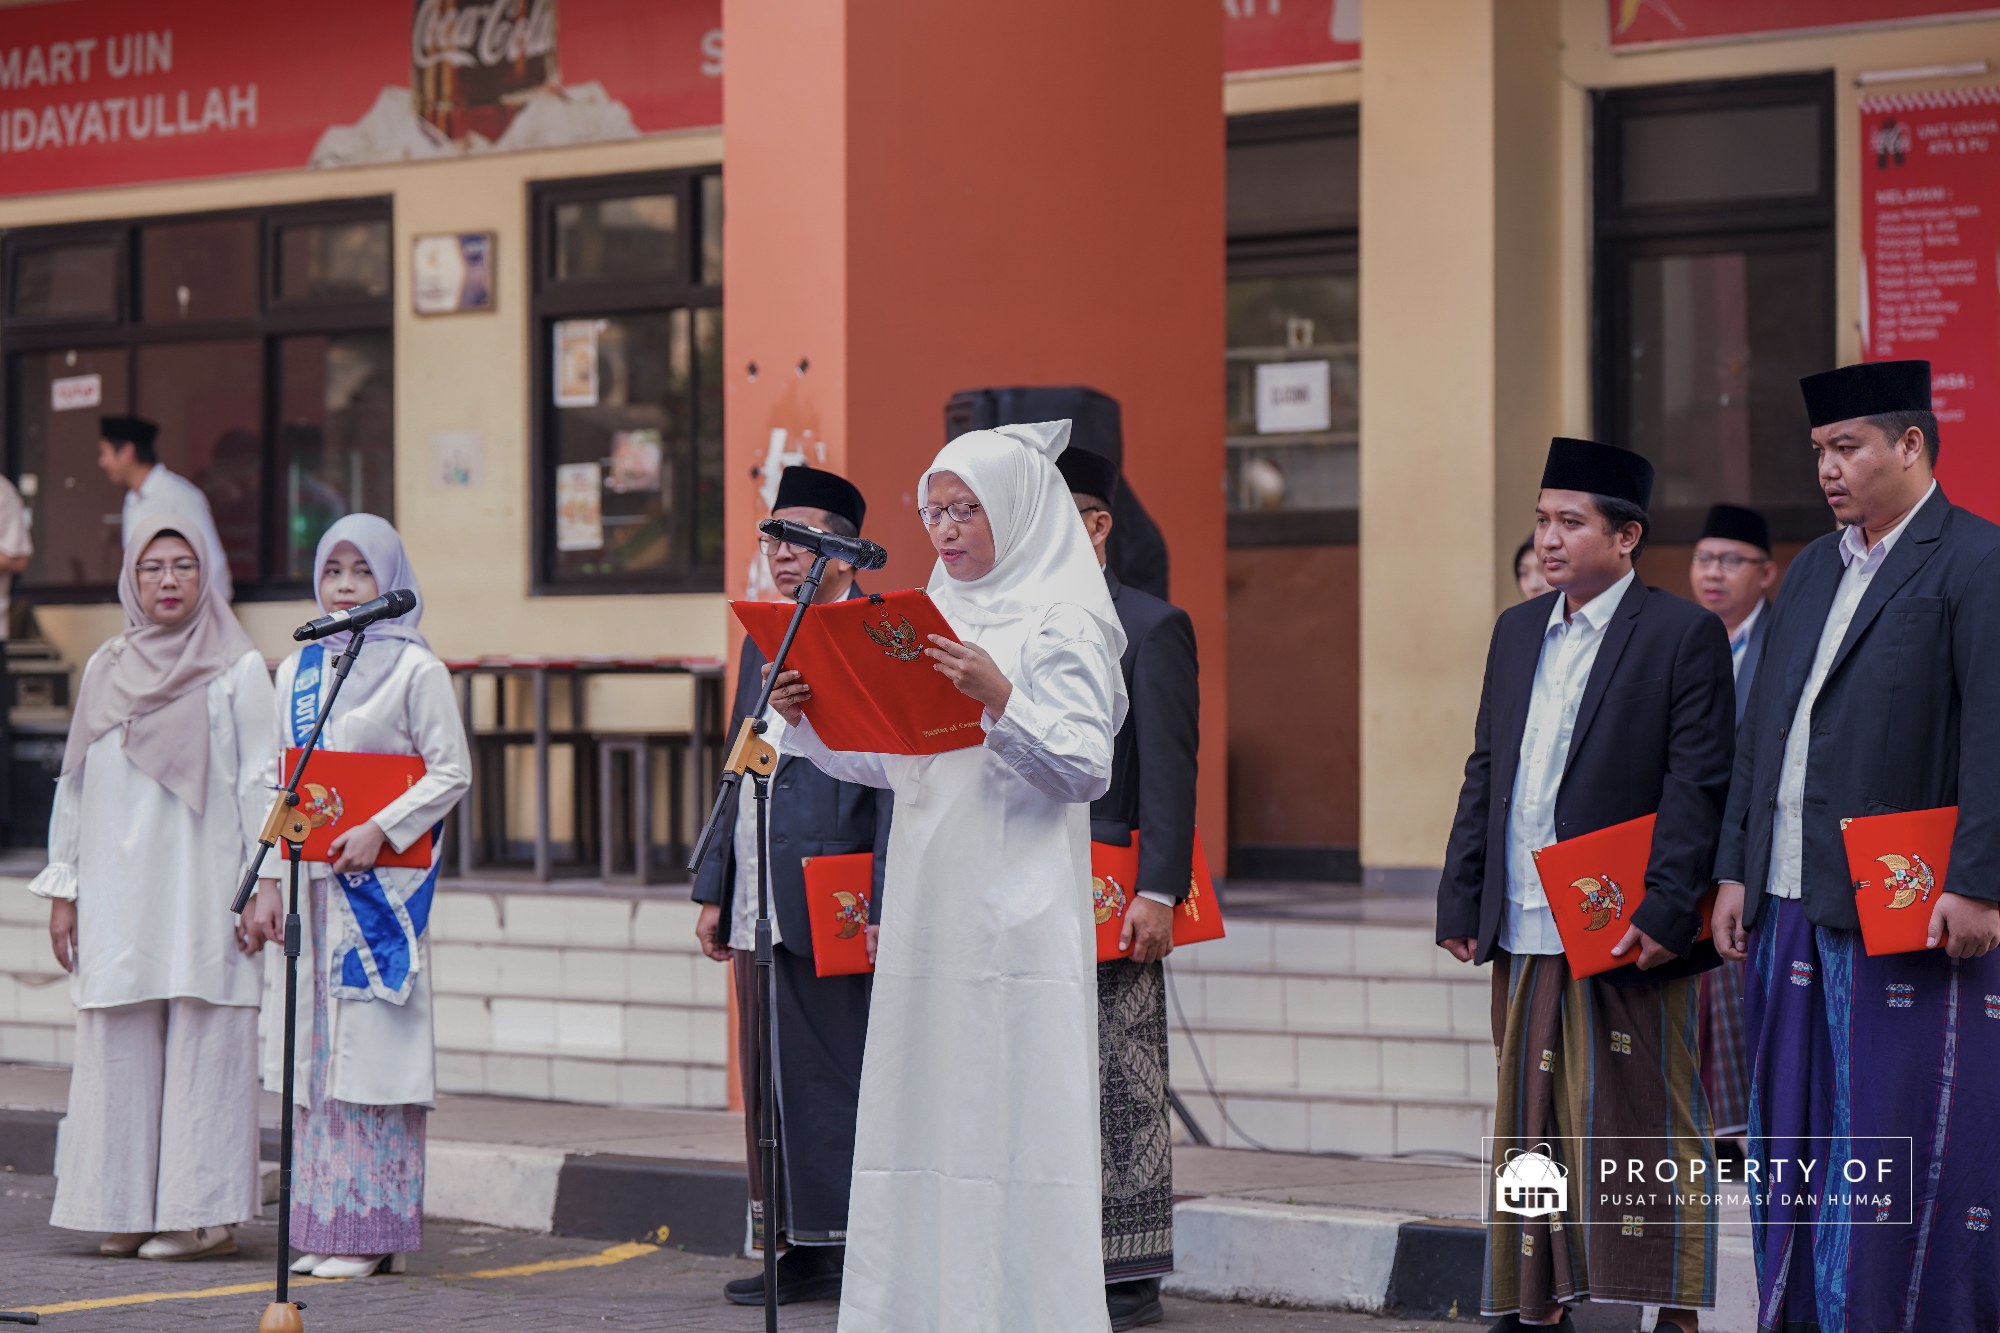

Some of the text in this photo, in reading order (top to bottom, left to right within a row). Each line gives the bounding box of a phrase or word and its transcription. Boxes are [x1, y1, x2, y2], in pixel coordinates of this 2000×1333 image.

[0, 30, 173, 90] MART UIN
[295, 693, 317, 738] DUTA
